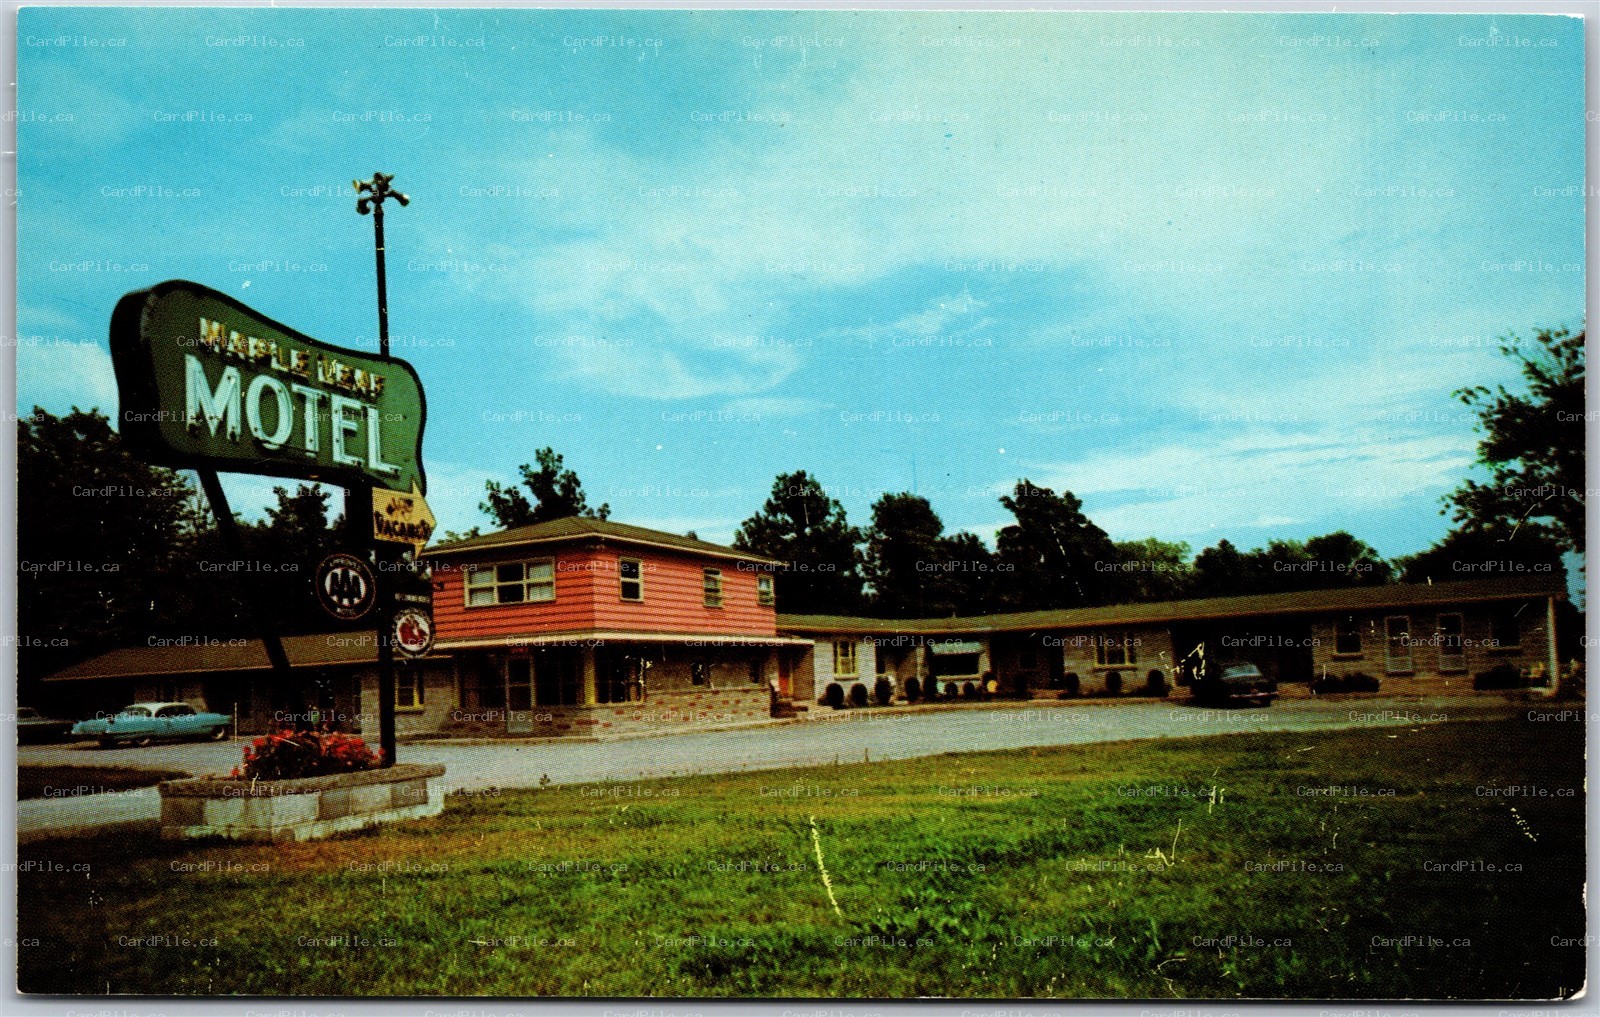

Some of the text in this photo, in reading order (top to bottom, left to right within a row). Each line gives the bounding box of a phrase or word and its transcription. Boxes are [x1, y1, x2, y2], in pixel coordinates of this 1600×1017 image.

[200, 317, 385, 397] MAPLE LEAF
[185, 353, 401, 471] MOTEL
[329, 570, 363, 605] AAA
